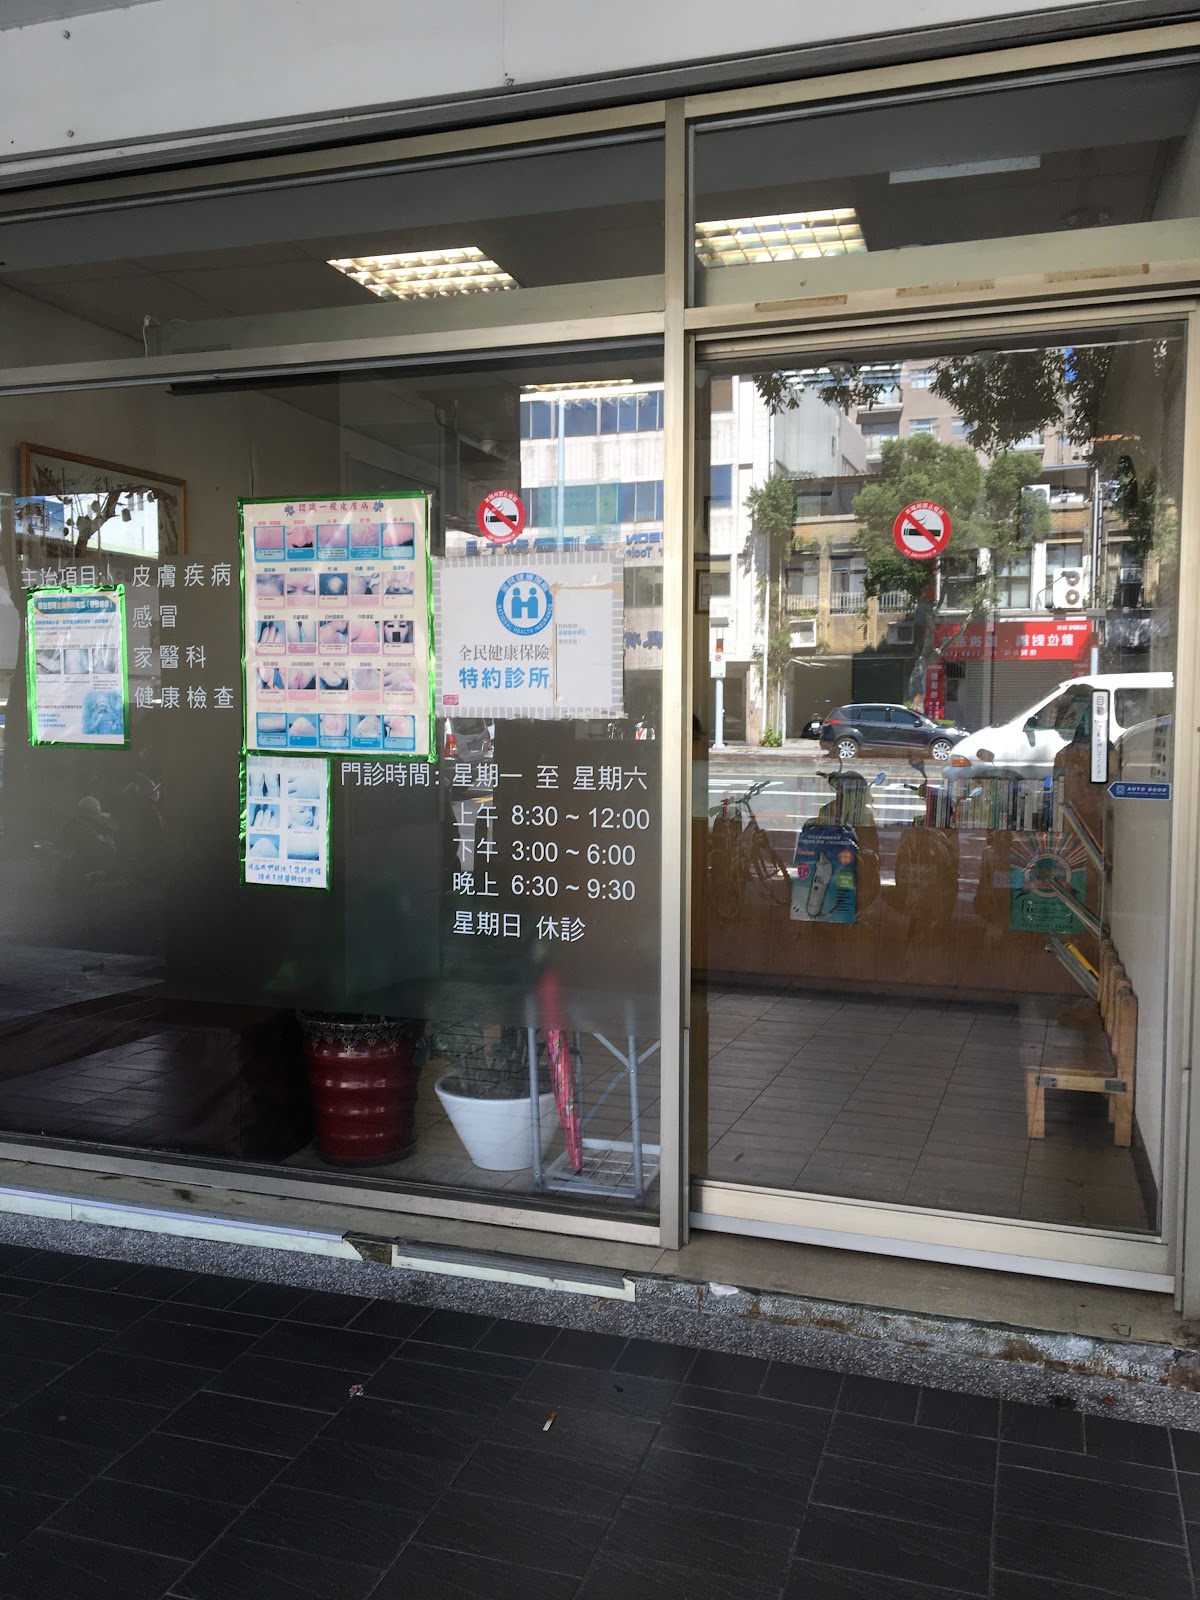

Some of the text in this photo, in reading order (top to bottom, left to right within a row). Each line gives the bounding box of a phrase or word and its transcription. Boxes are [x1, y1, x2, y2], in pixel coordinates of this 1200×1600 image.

[132, 562, 232, 588] 皮膚疾病
[133, 604, 178, 629] 感冒
[133, 644, 207, 669] 家醫科
[458, 644, 550, 661] 全民健康保險
[459, 666, 550, 689] 特約診所
[135, 685, 235, 710] 健康檢查
[341, 761, 441, 787] 門診時間:
[452, 763, 523, 789] 星期一
[536, 765, 559, 790] 至
[573, 765, 648, 792] 星期六
[452, 803, 499, 829] 上午
[511, 805, 558, 827] 8:30
[588, 807, 650, 831] 12:00
[452, 838, 499, 863] 下午
[511, 840, 559, 863] 3:00
[587, 843, 636, 867] 6:00
[452, 871, 499, 897] 晚上
[511, 874, 558, 897] 6:30
[587, 878, 636, 902] 9:30
[452, 910, 586, 942] 星期日 休診
